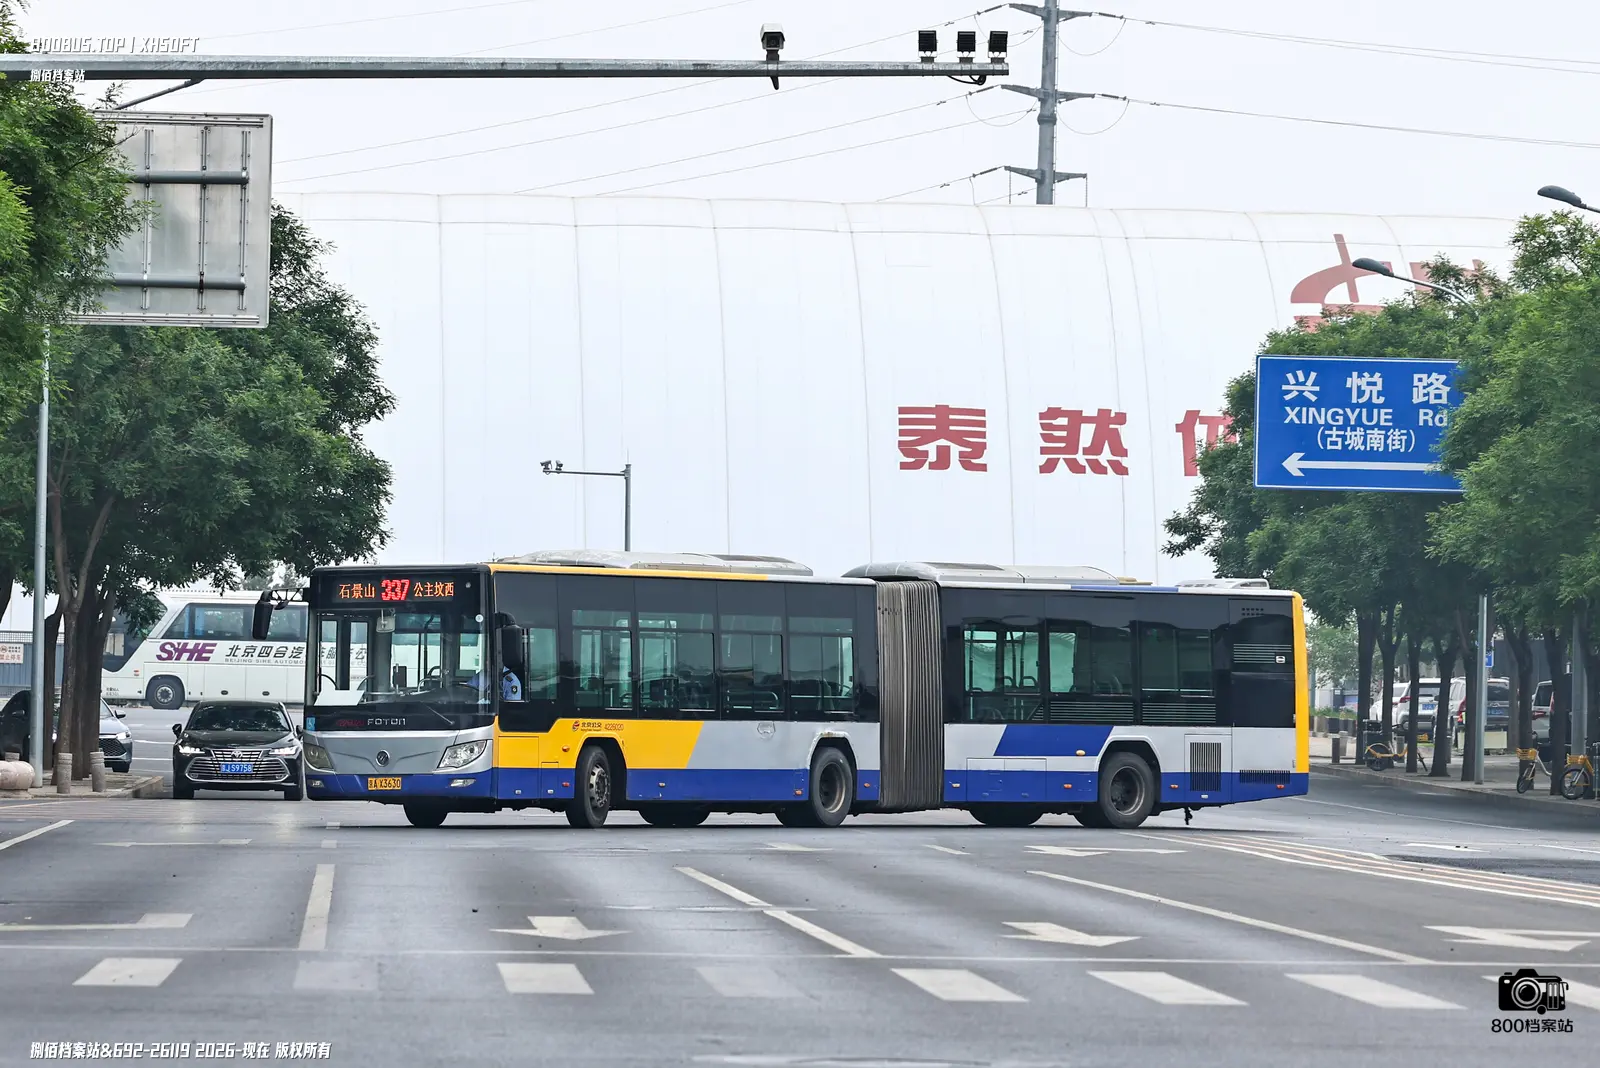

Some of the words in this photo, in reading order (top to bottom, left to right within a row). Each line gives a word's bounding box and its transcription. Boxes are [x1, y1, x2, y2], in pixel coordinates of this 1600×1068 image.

[1282, 370, 1451, 404] 兴悦路
[1284, 406, 1393, 426] XINGYUE
[1317, 426, 1416, 452] (古城南街)
[339, 583, 375, 599] 石景山
[381, 579, 410, 600] 337
[413, 581, 454, 597] 公主坟西
